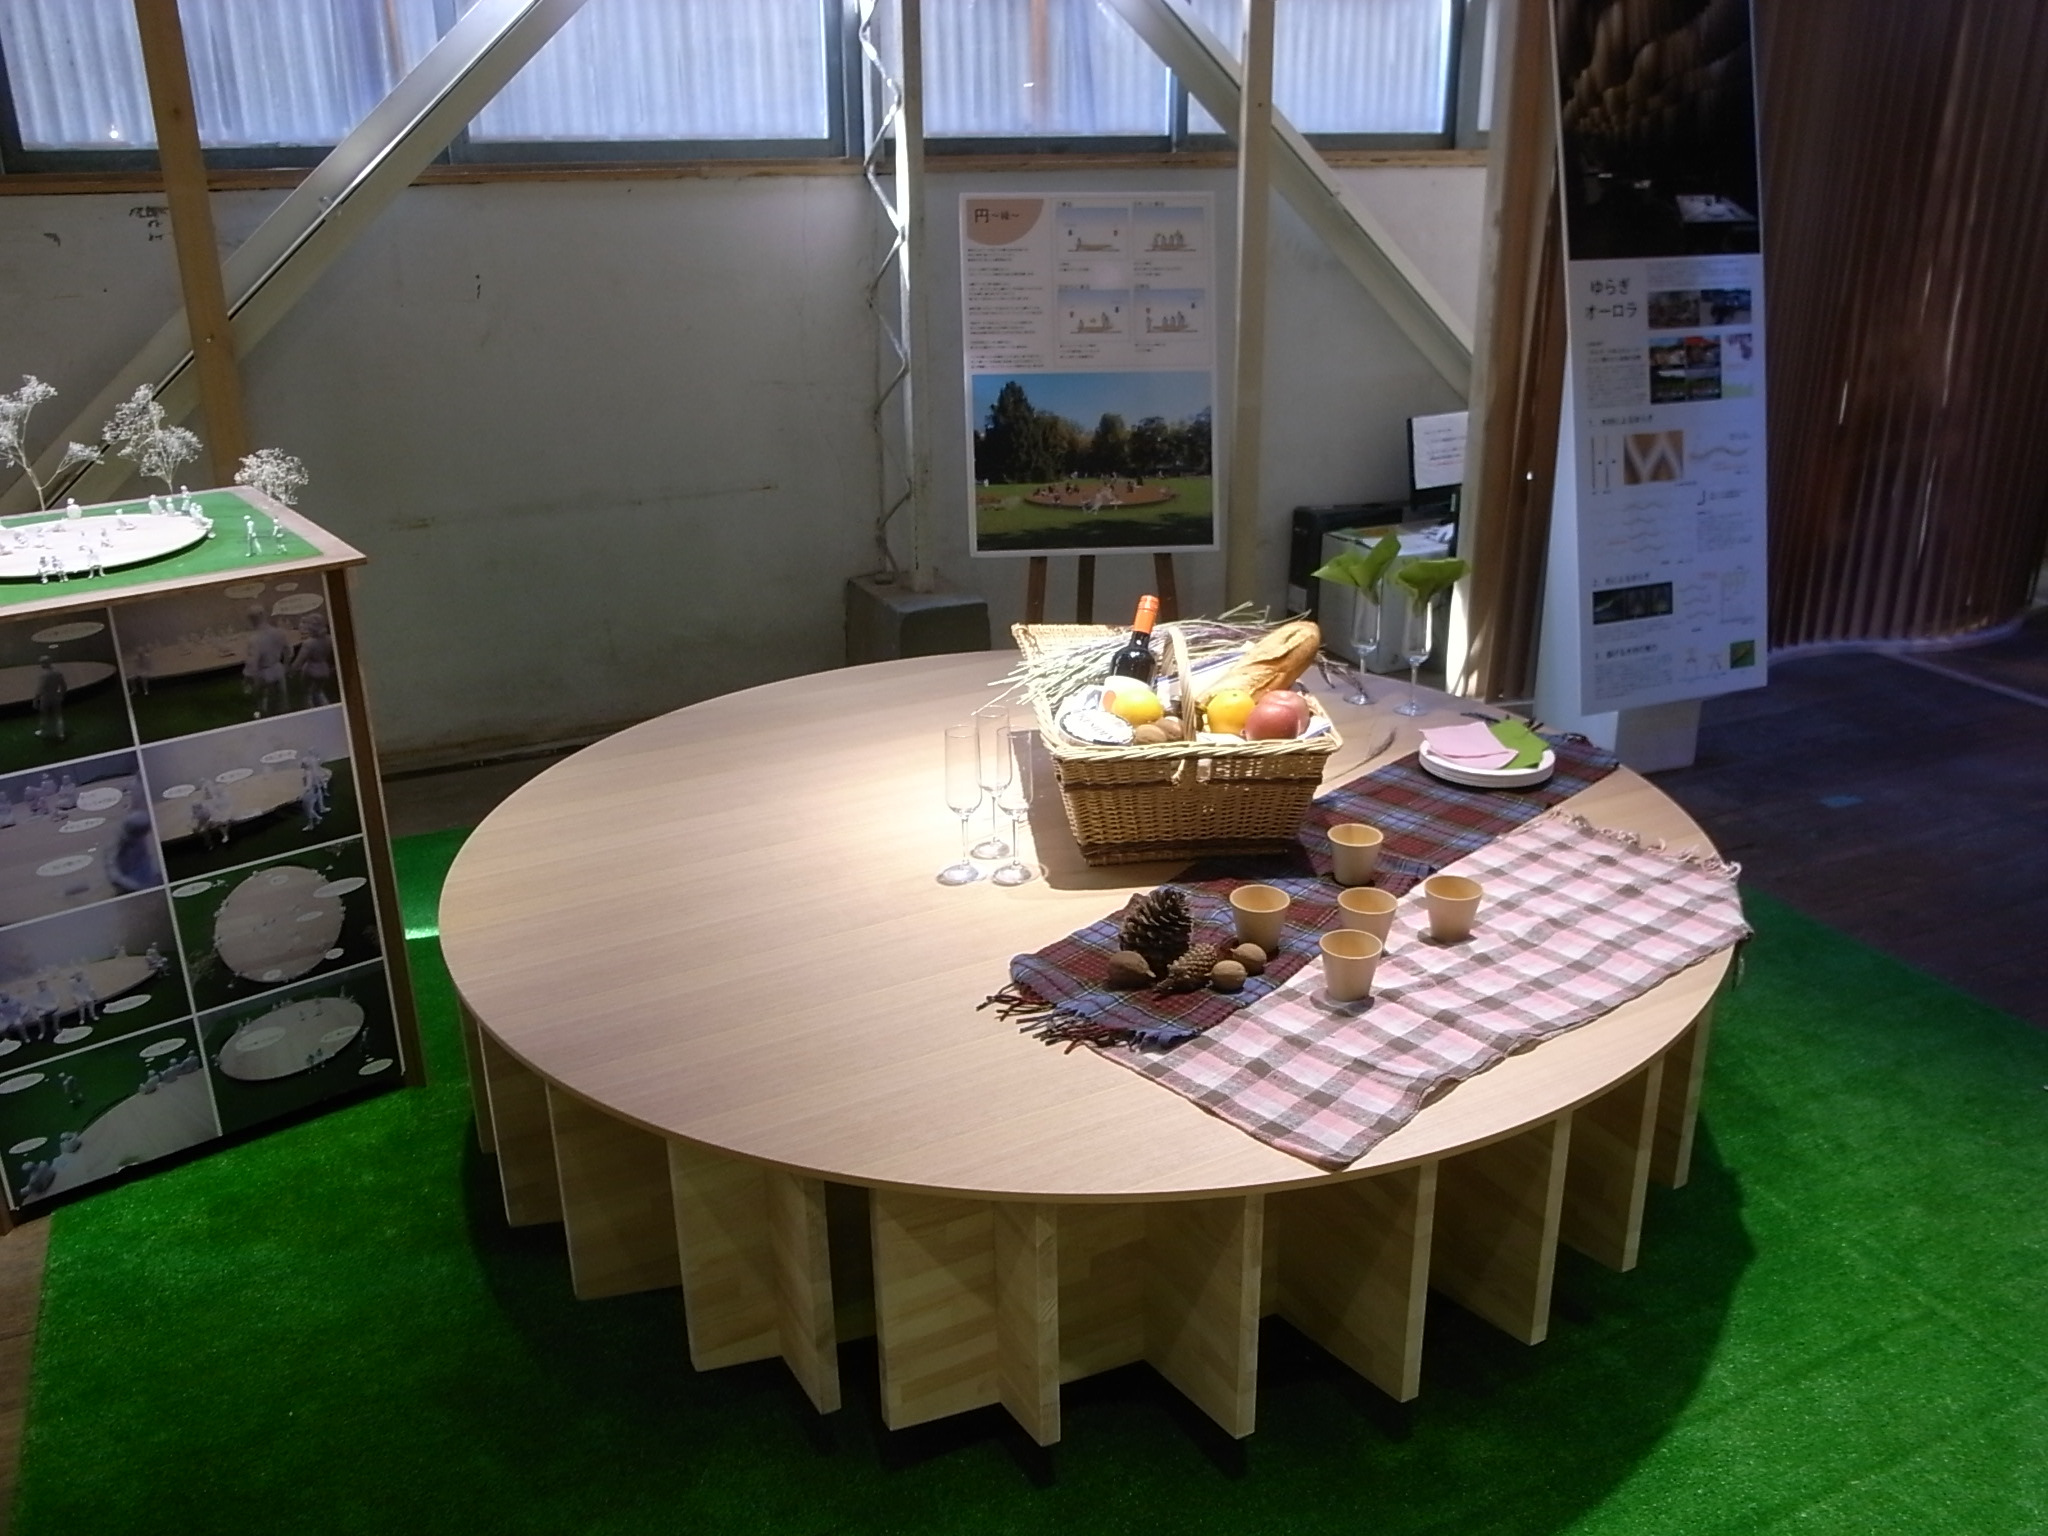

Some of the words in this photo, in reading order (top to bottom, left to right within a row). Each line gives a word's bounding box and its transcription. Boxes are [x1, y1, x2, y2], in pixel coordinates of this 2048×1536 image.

[1590, 277, 1631, 295] ゆらぎ
[1584, 300, 1638, 321] オーロラ
